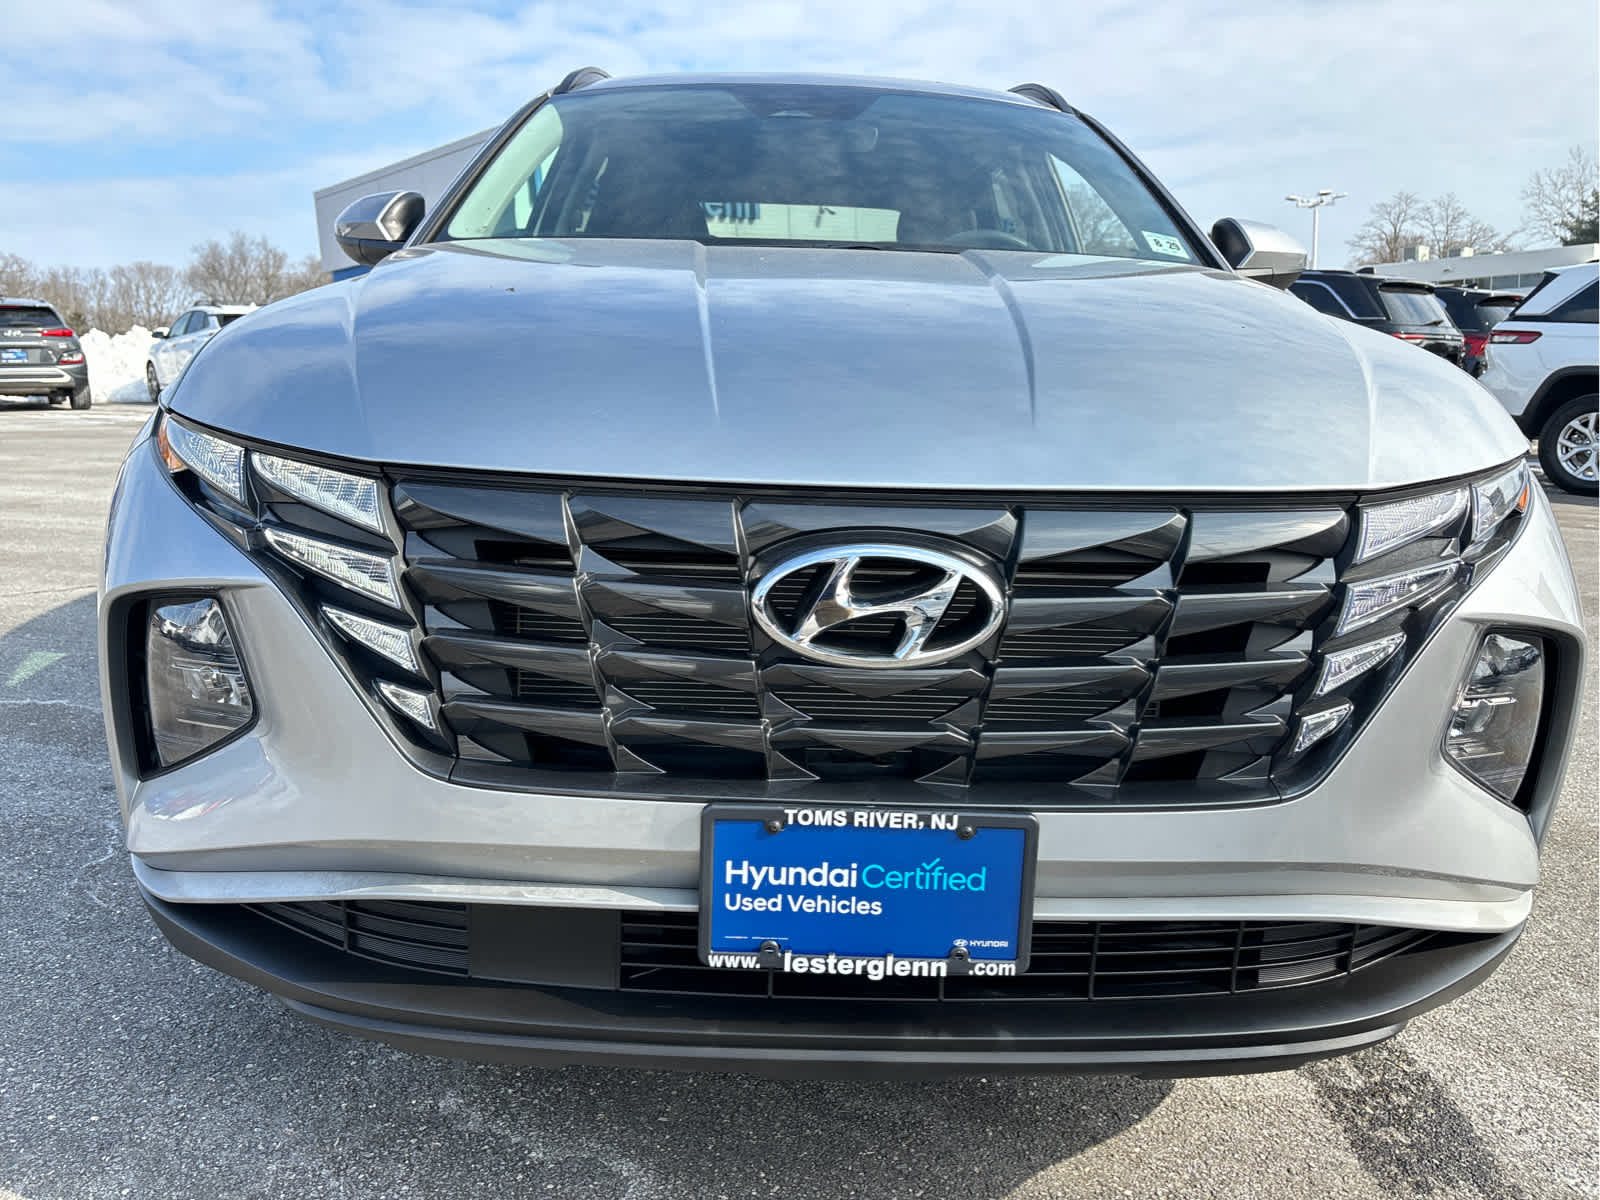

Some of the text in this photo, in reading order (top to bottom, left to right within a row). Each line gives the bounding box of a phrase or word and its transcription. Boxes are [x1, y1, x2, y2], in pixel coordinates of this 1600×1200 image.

[784, 808, 959, 831] TOMS RIVER, NJ
[725, 857, 987, 891] Hyundai Certified
[724, 893, 883, 915] Used Vehicles
[969, 940, 1009, 948] HYUNDAI
[708, 951, 1016, 981] www. lesterglenn .com
